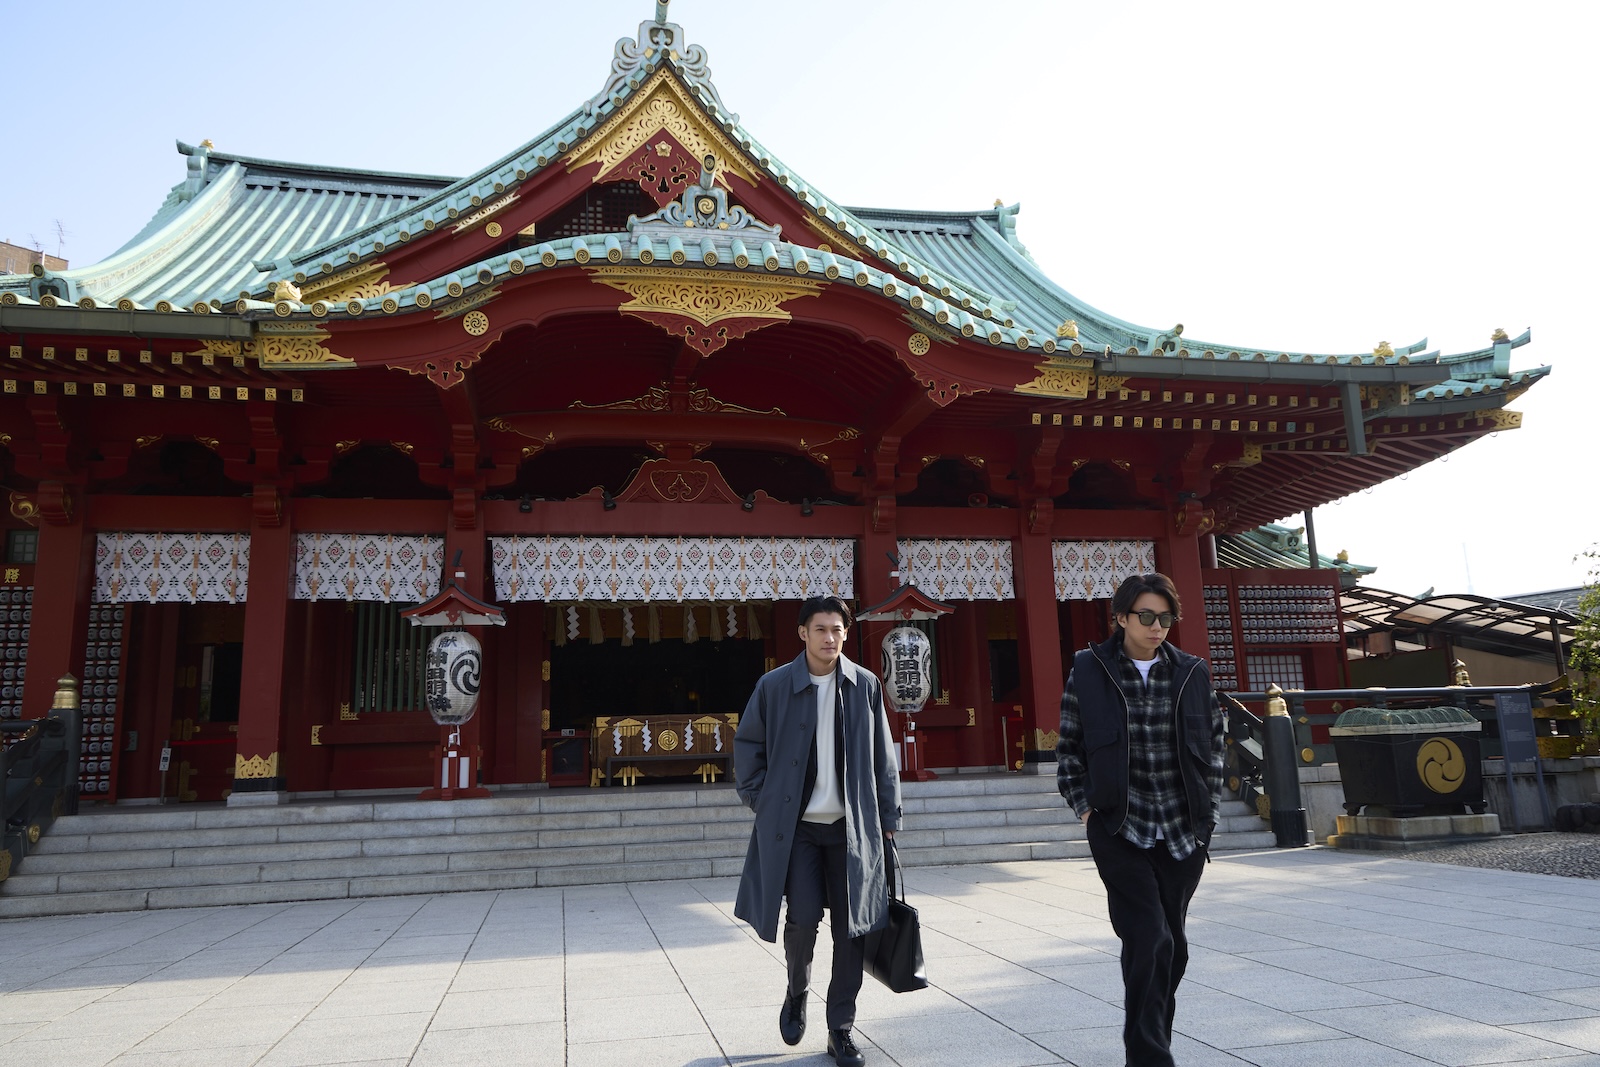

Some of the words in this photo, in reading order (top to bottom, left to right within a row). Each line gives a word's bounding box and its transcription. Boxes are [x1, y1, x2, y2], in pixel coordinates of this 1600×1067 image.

[427, 648, 452, 712] 神田明神
[893, 643, 922, 701] 神田明神
